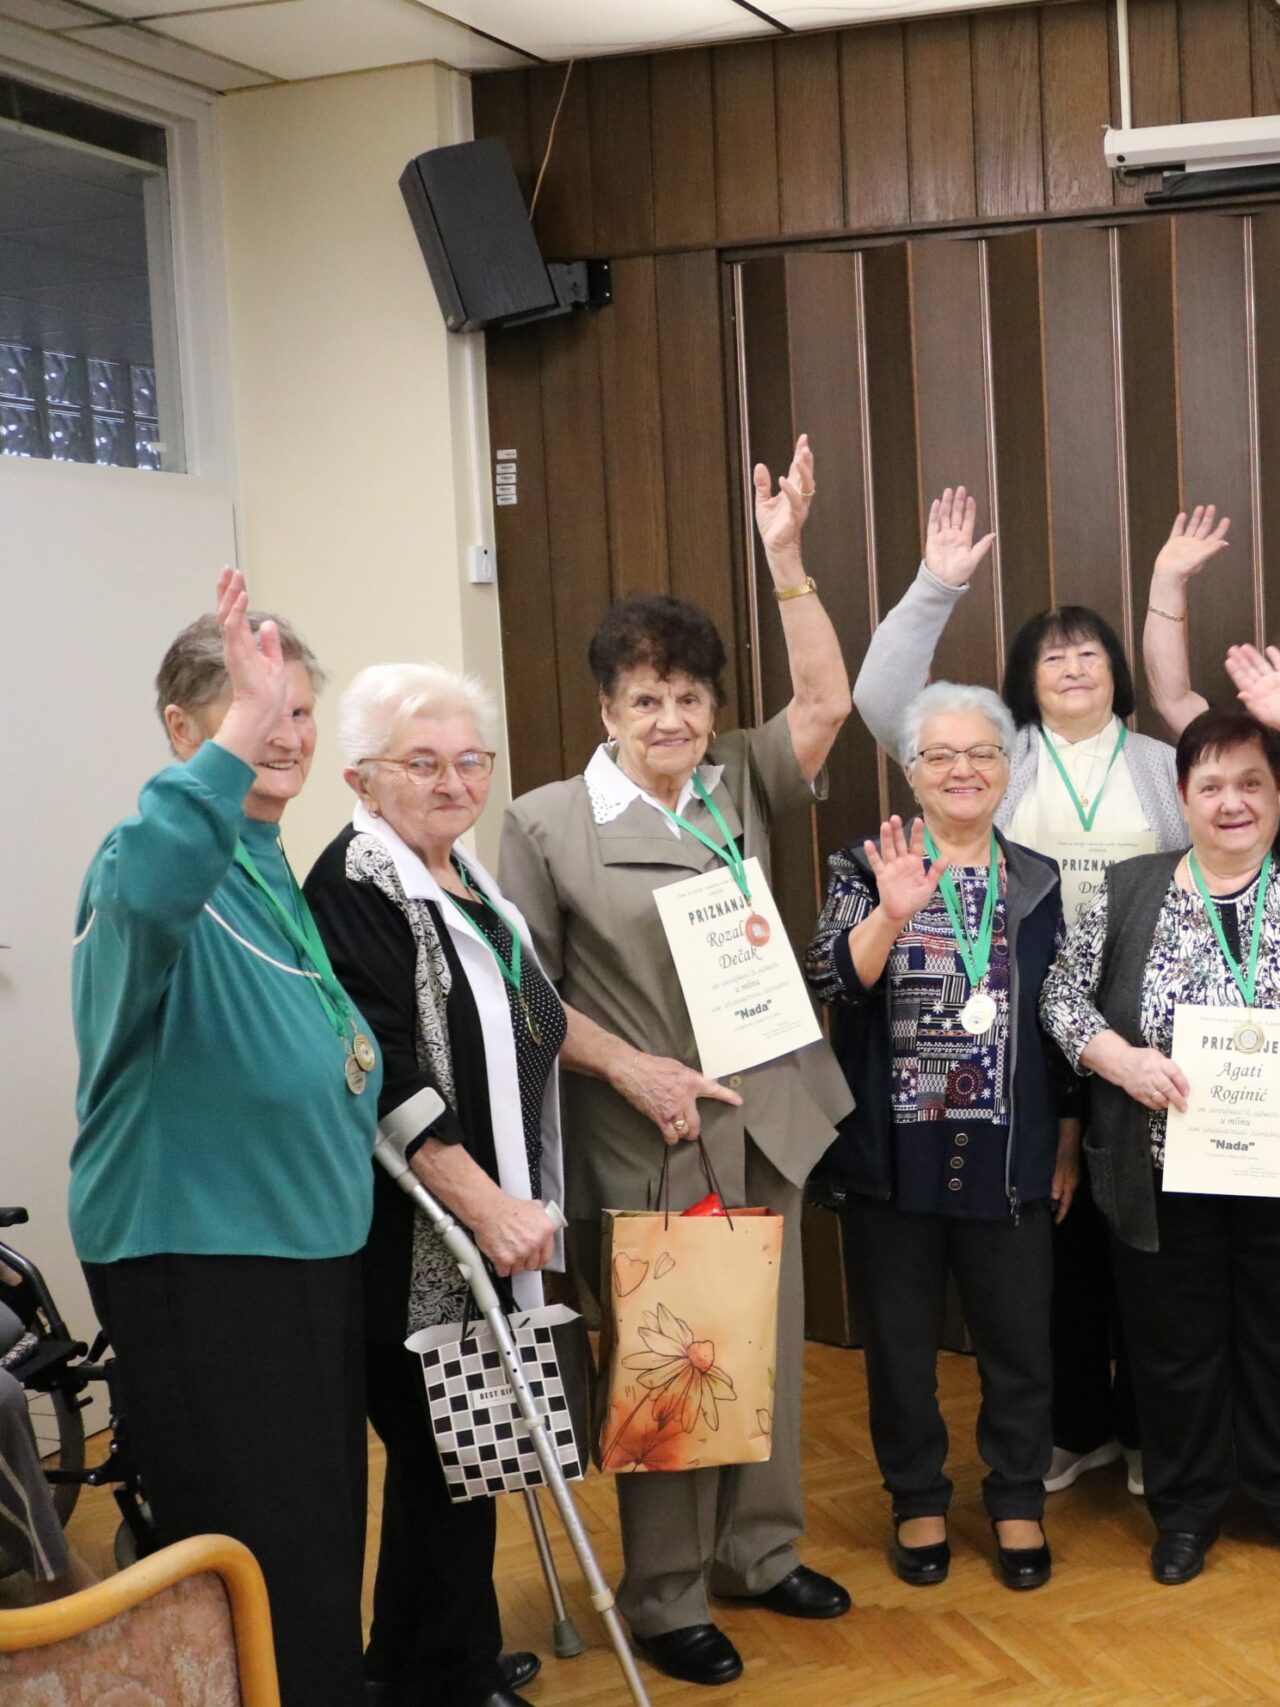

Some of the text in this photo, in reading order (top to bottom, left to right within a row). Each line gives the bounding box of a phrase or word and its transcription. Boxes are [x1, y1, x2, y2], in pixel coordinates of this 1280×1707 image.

[706, 919, 745, 947] Rozal
[718, 947, 763, 970] Dečak
[734, 999, 772, 1020] "Nada"
[1202, 1035, 1279, 1055] PRIZJE
[1216, 1062, 1263, 1081] Agati
[1210, 1085, 1268, 1104] Roginić
[1210, 1138, 1255, 1152] "Nada"
[501, 1387, 513, 1396] GIF
